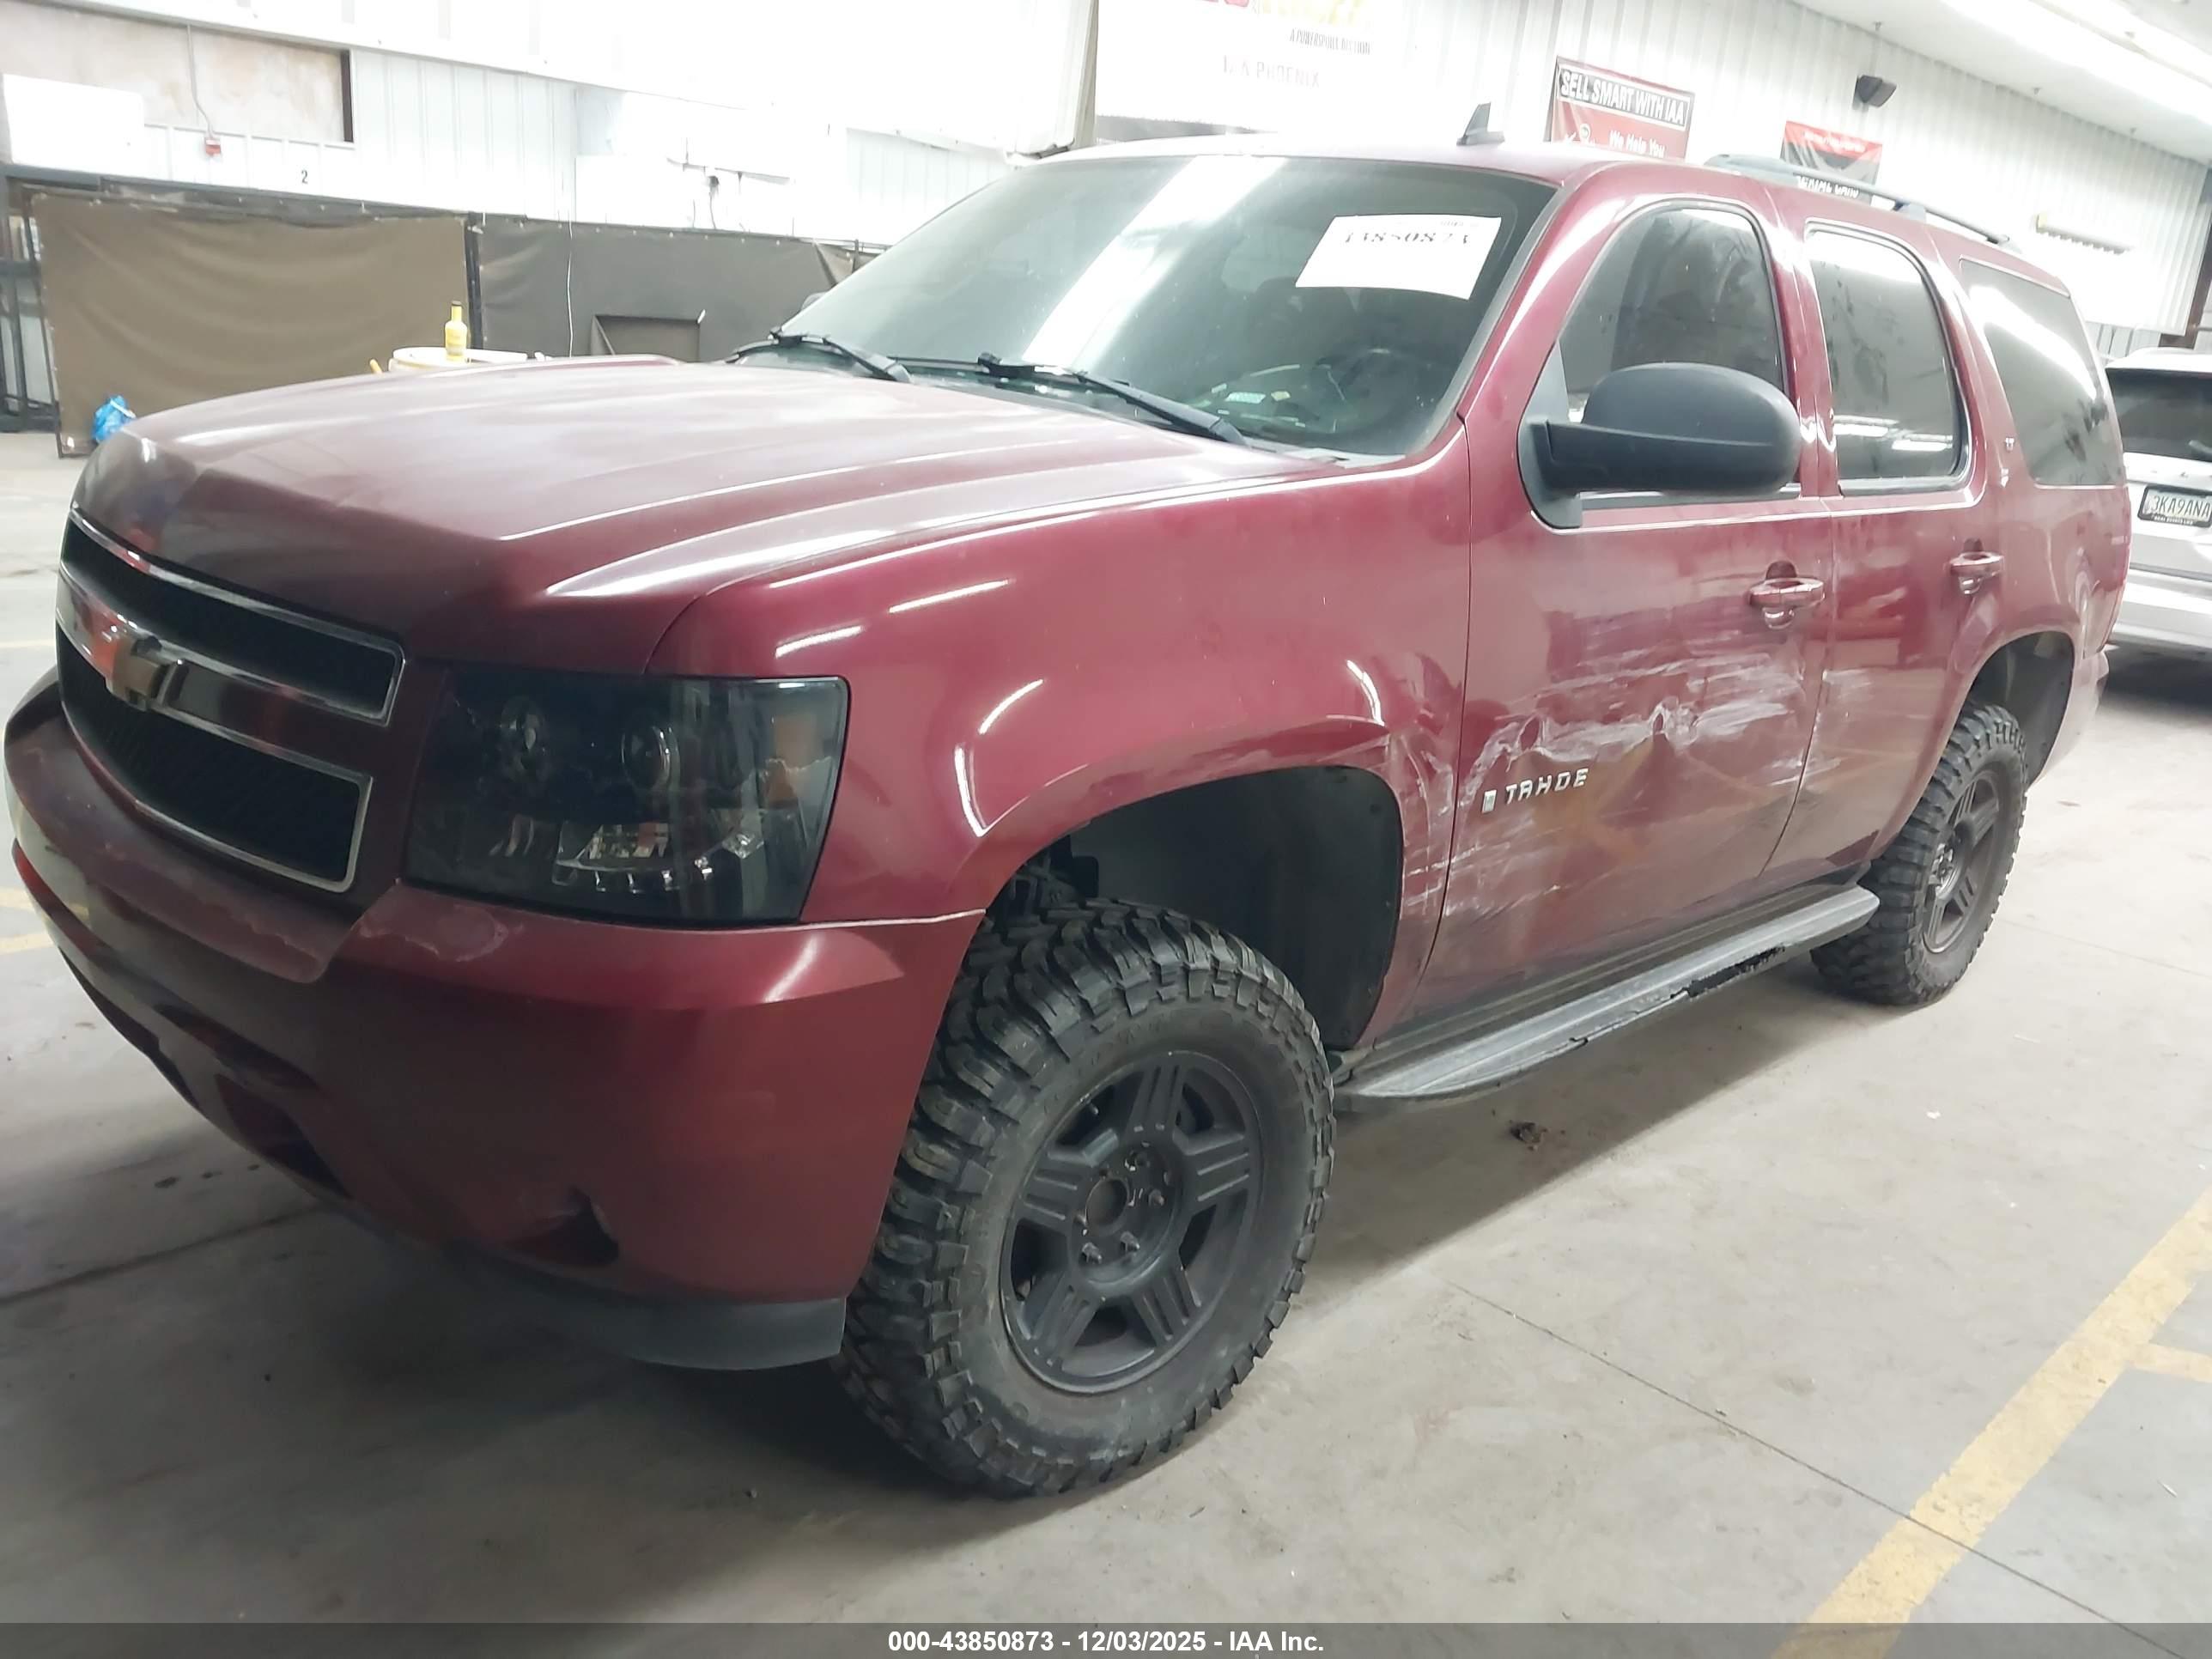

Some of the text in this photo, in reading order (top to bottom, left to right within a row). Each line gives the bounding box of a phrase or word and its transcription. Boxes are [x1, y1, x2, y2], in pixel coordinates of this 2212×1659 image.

[1256, 61, 1320, 88] PHOENIX
[1561, 70, 1685, 125] SELL SMART WITH IAA
[1609, 130, 1665, 158] We Help You
[301, 169, 308, 185] 2
[1505, 769, 1589, 805] TAHOE
